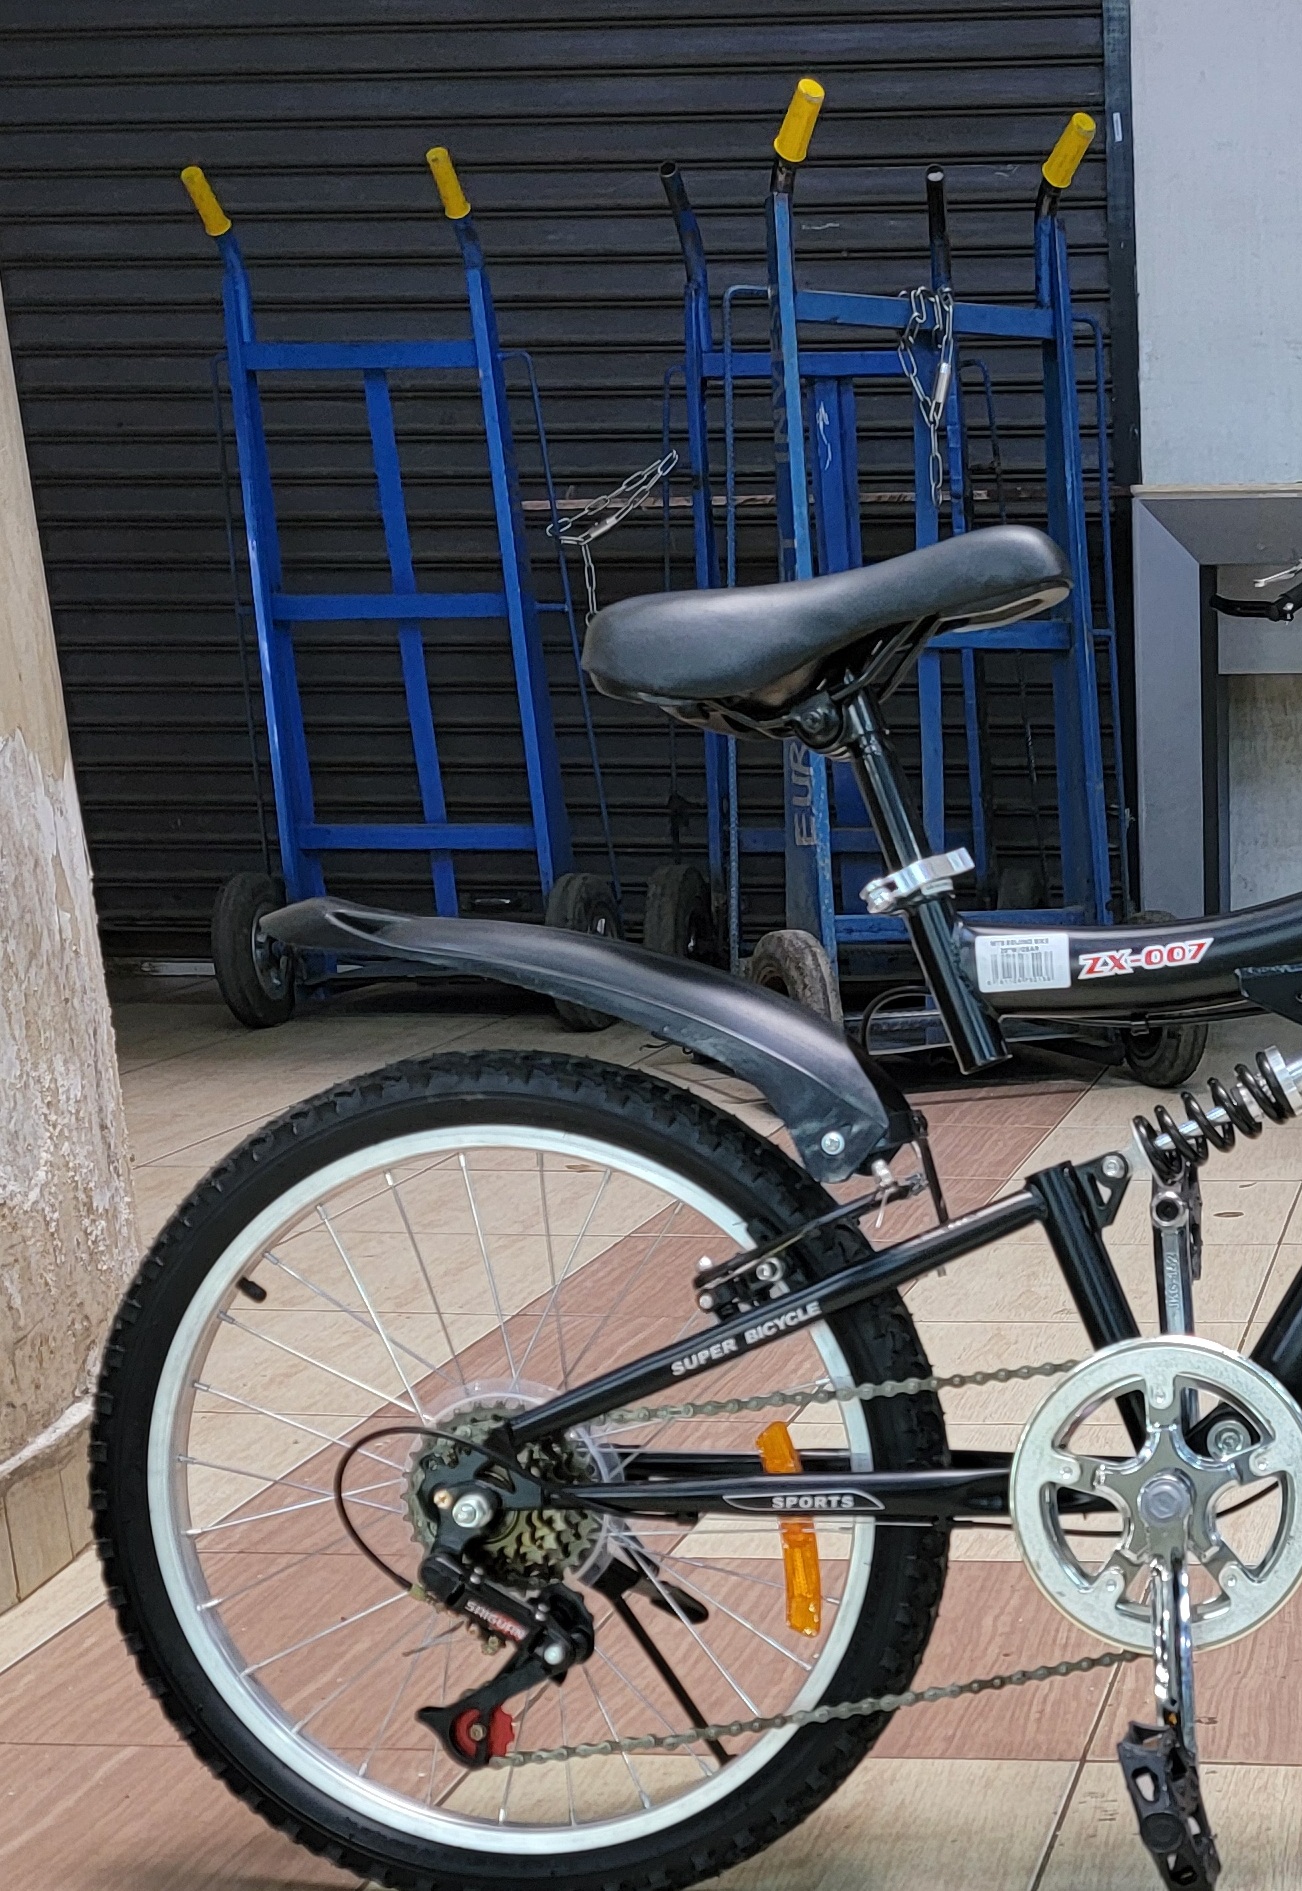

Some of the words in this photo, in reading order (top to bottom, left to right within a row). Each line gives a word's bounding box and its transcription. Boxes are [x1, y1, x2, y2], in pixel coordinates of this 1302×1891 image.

[1078, 937, 1214, 979] ZX-007
[670, 1337, 739, 1376] SUPER
[744, 1300, 823, 1345] BICYCLE
[771, 1494, 855, 1510] SPORTS
